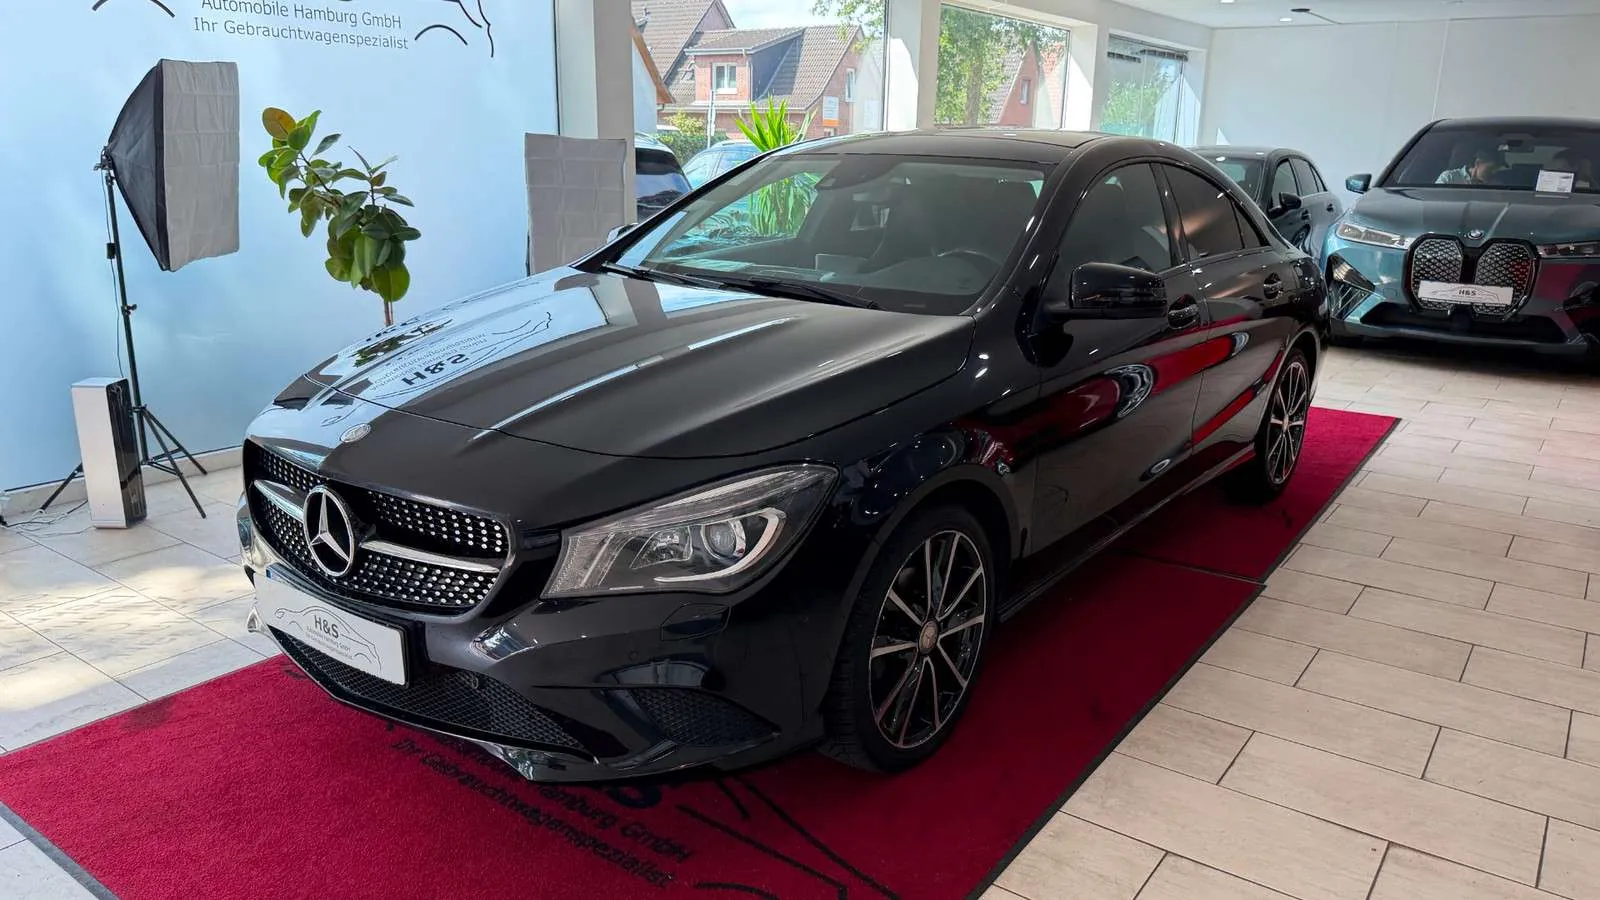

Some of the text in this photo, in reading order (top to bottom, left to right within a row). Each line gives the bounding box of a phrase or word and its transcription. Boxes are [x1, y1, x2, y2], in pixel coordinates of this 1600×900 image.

[201, 0, 402, 29] Automobile Hamburg GmbH
[194, 16, 409, 49] Ihr Gebrauchtwagenspezialist
[313, 615, 340, 639] H&S
